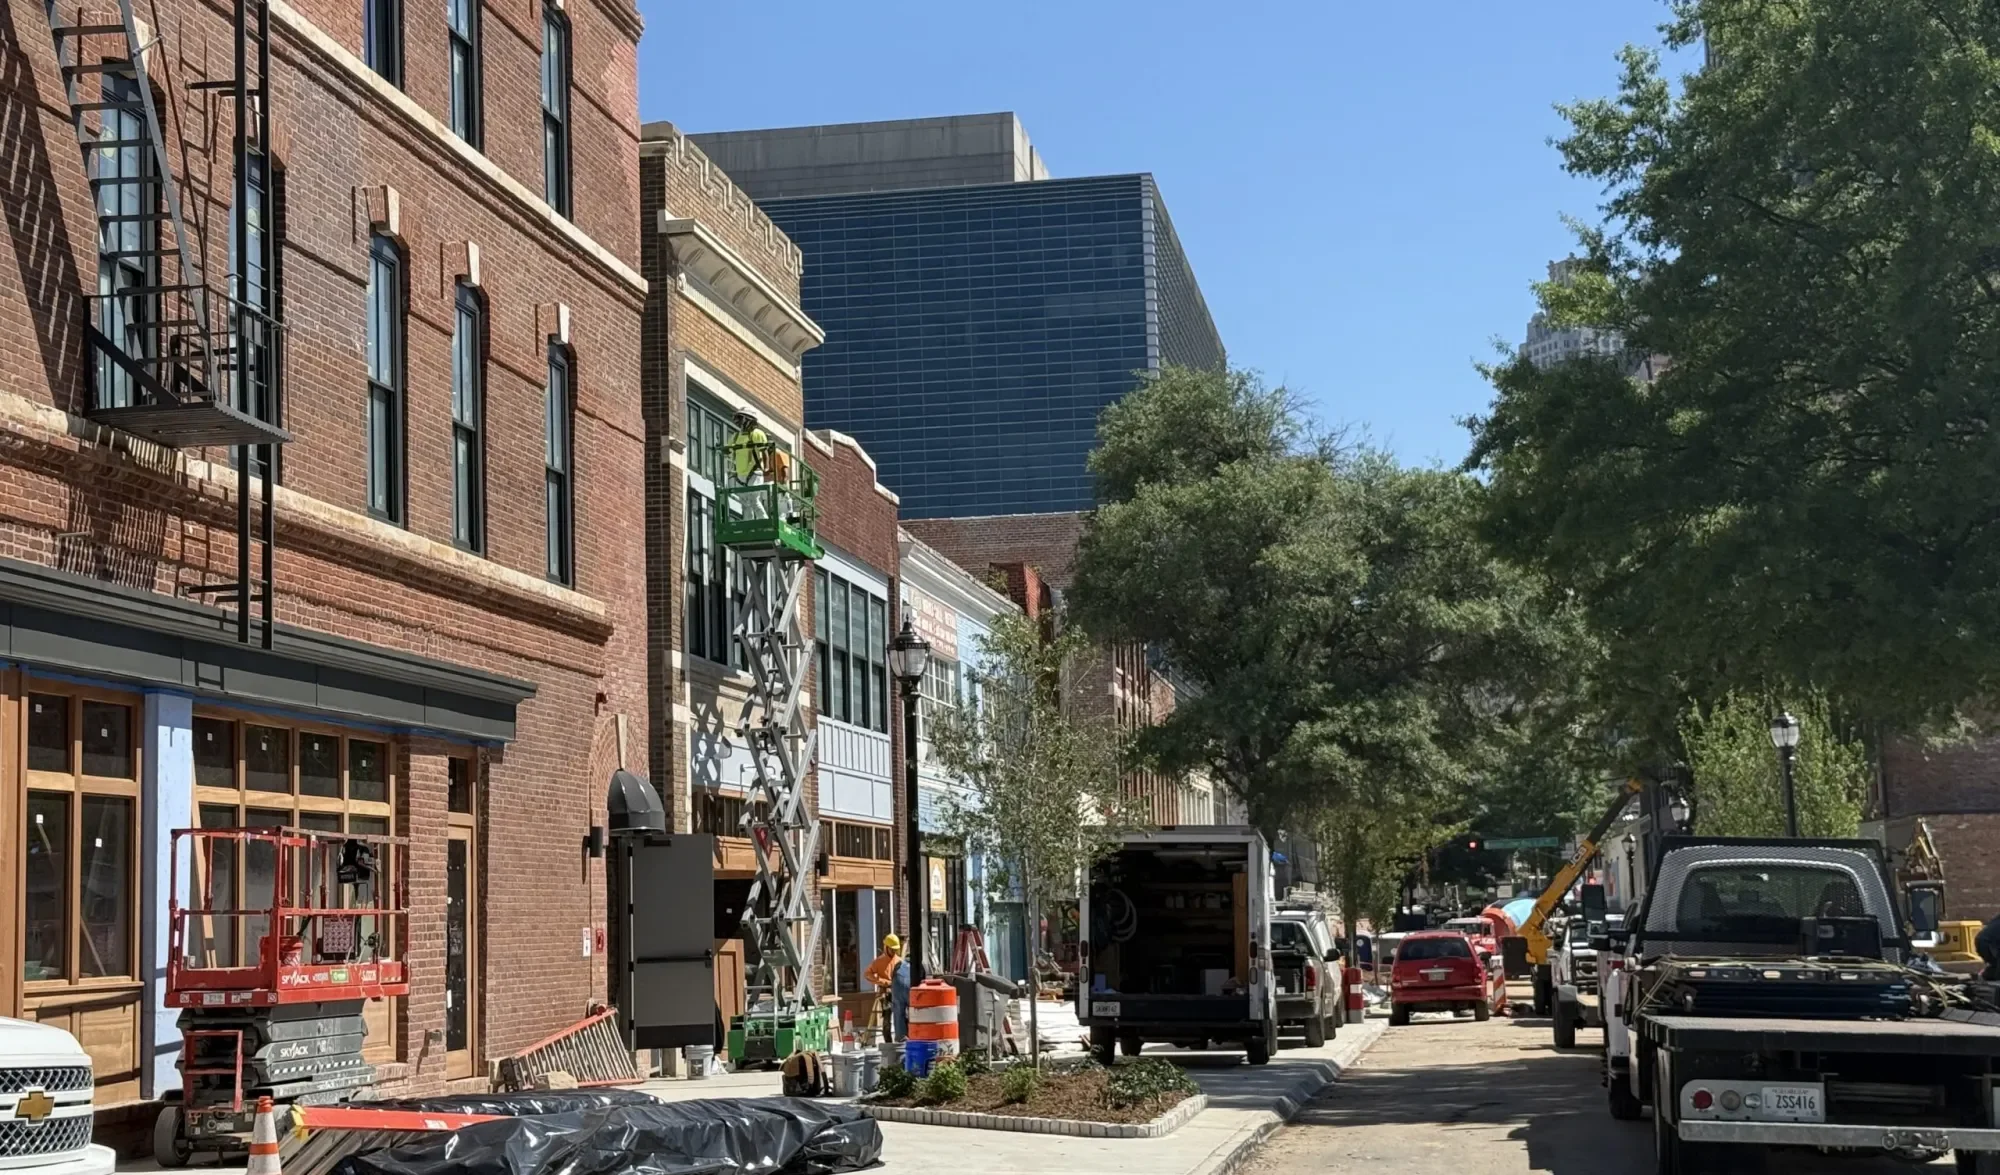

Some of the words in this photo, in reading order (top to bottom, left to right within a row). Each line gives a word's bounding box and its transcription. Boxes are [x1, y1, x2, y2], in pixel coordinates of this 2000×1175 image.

[1569, 846, 1587, 868] JCB
[281, 970, 311, 986] SKYJACK
[280, 1042, 309, 1059] SKYJACK
